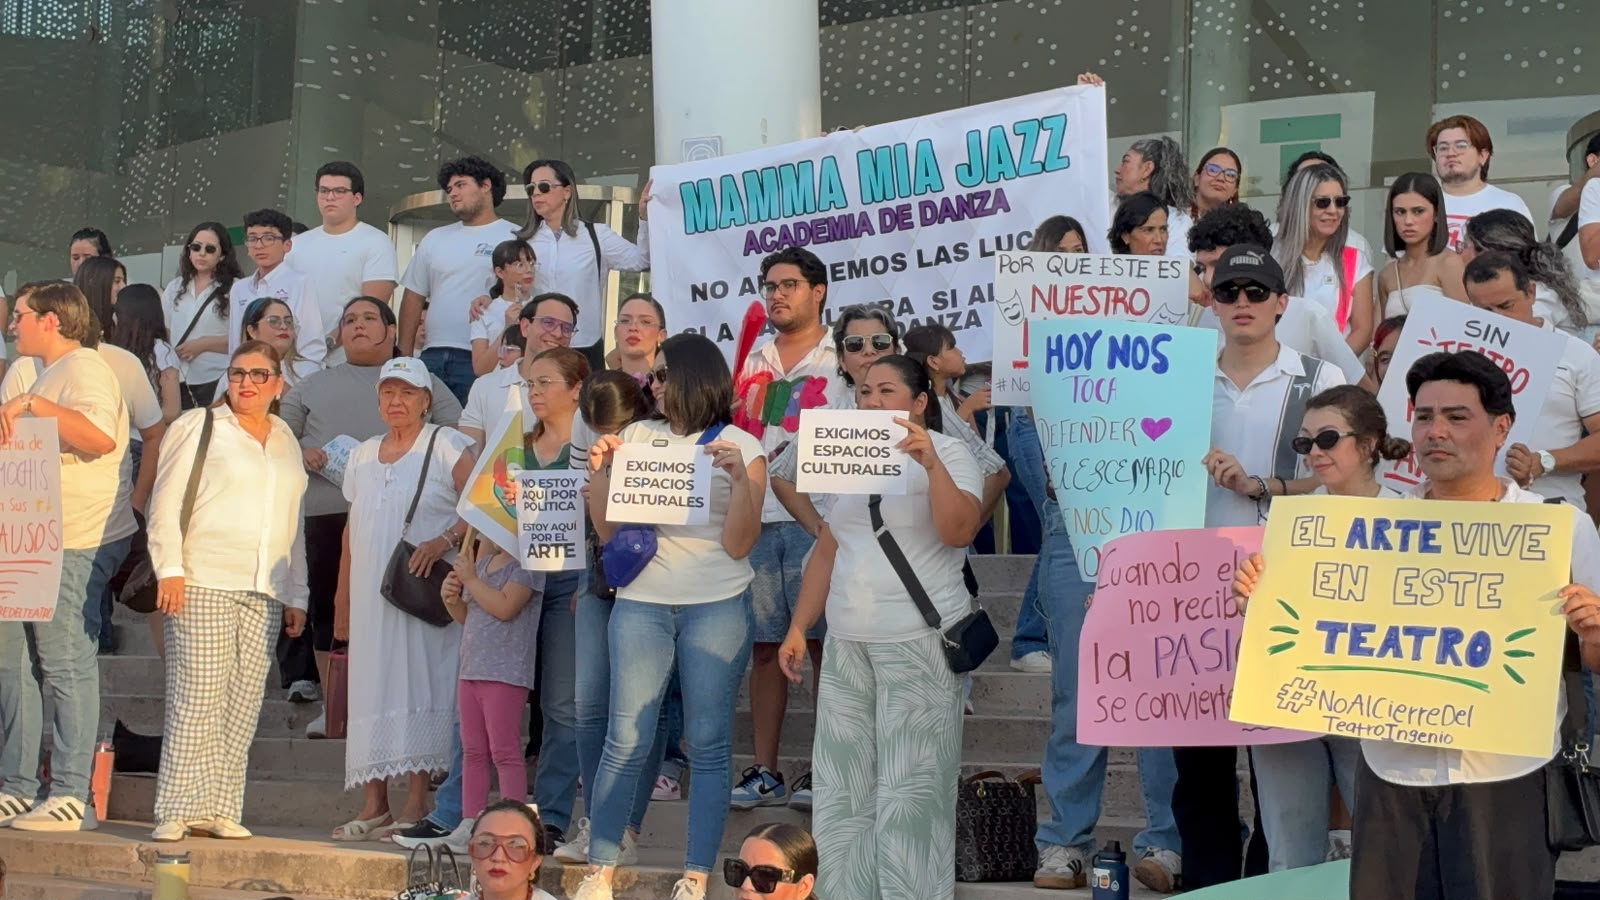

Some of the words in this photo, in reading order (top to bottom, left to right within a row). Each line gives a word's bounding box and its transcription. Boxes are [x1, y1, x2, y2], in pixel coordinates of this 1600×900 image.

[679, 155, 848, 235] MAMMA
[856, 138, 944, 205] MIA
[955, 113, 1070, 188] JAZZ
[743, 210, 874, 256] ACADEMIA
[879, 205, 915, 234] DE
[920, 188, 1010, 227] DANZA
[691, 280, 729, 302] NO
[916, 242, 969, 269] LAS
[998, 254, 1034, 274] POR
[1046, 255, 1093, 277] QUE
[1099, 257, 1147, 279] ESTE
[1158, 259, 1181, 279] ES
[932, 288, 957, 310] SI
[1030, 284, 1151, 316] NUESTRO
[1464, 320, 1511, 349] SIN
[1045, 329, 1103, 374] HOY
[1107, 333, 1173, 374] NOS
[1062, 375, 1117, 404] TOCA
[814, 427, 890, 441] EXIGIMOS
[1037, 416, 1137, 453] DEFENDER
[813, 445, 891, 459] ESPACIOS
[626, 460, 695, 474] EXIGIMOS
[801, 462, 902, 476] CULTURALES
[522, 478, 535, 488] NO
[539, 478, 578, 488] ESTOY
[551, 490, 578, 500] POR
[624, 477, 694, 492] ESPACIOS
[611, 493, 705, 508] CULTURALES
[523, 523, 549, 531] ESTOY
[1074, 507, 1112, 535] NOS
[1120, 507, 1154, 533] DIO
[527, 543, 577, 558] ARTE
[531, 533, 552, 542] POR
[555, 533, 568, 541] EL
[1291, 515, 1336, 548] EL
[1345, 517, 1442, 554] ARTE
[1451, 522, 1551, 561] VIVE
[1097, 542, 1200, 590] Cuando
[1313, 562, 1369, 602] EN
[1393, 567, 1505, 609] ESTE
[1129, 598, 1161, 625] no
[1094, 642, 1132, 685] la
[1154, 628, 1242, 679] PASI
[1315, 620, 1492, 669] TEATRO
[1094, 695, 1126, 723] se
[1276, 676, 1475, 728] #NoAlCierreDel
[1322, 715, 1454, 746] TeatroIngenio
